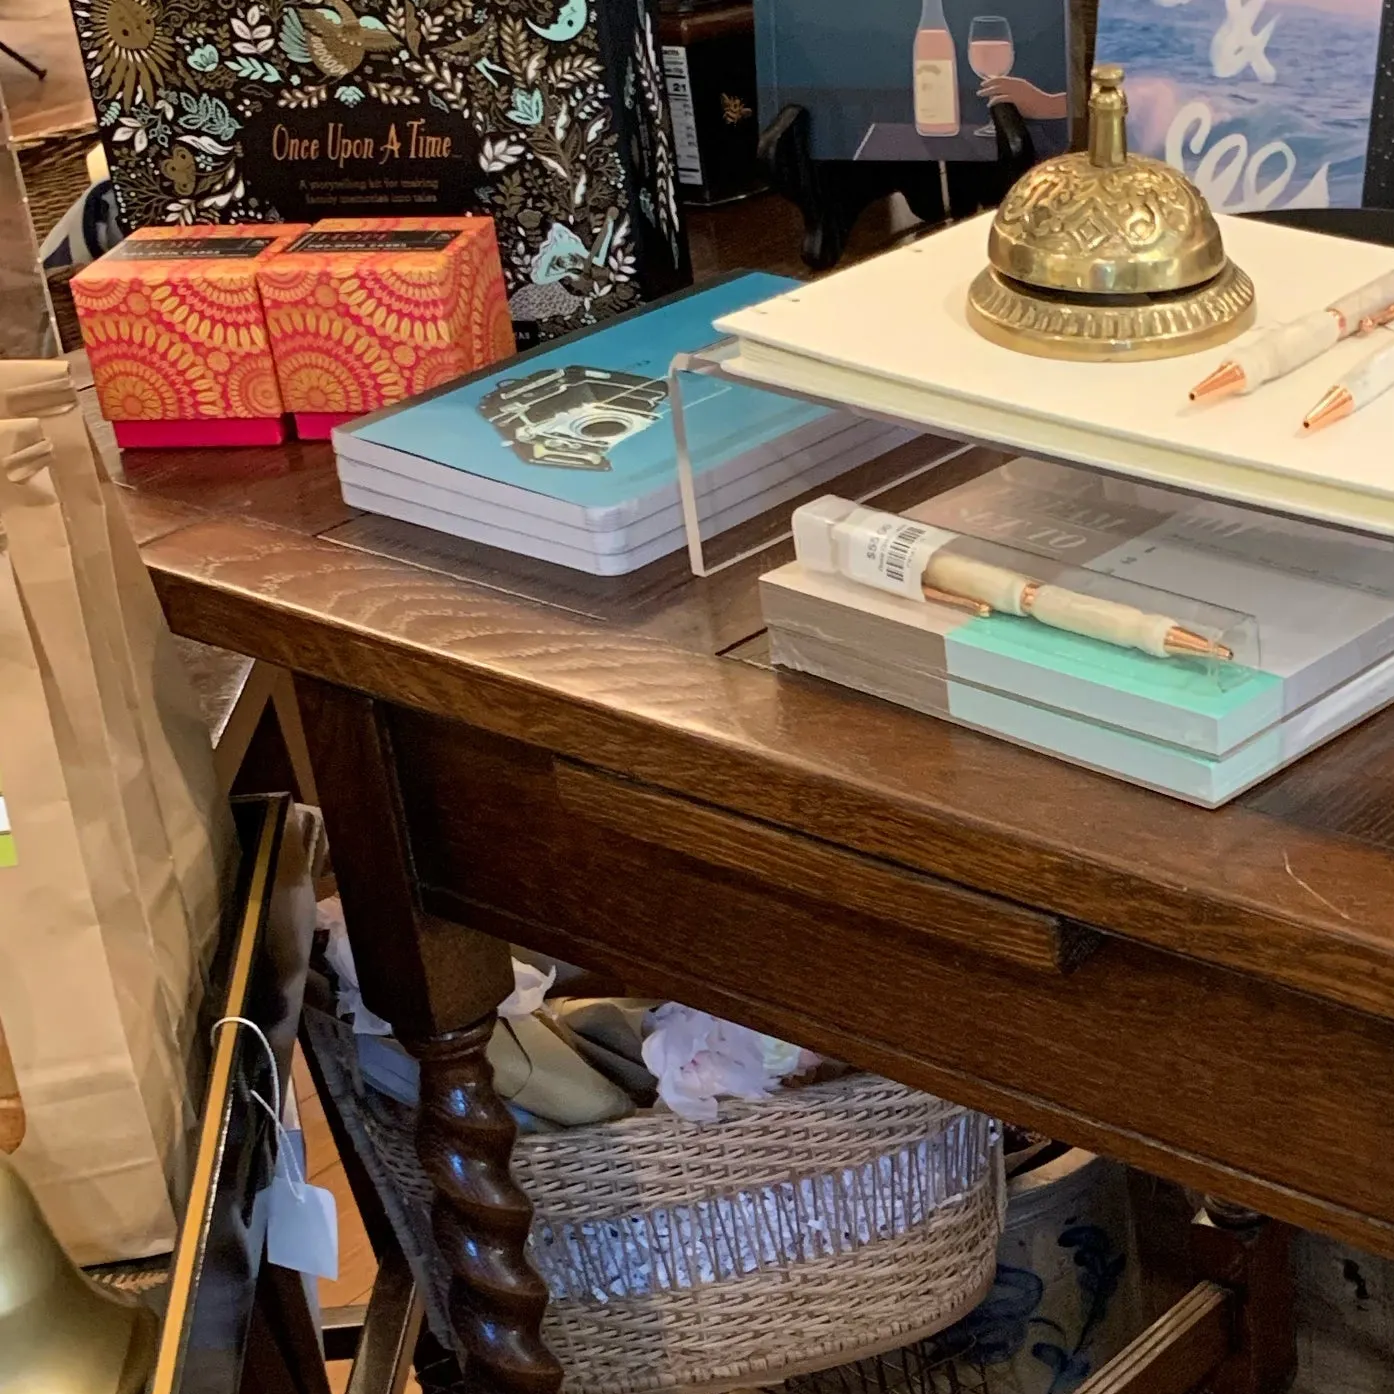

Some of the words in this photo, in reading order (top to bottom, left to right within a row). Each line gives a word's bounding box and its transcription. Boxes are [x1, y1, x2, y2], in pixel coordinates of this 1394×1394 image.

[672, 83, 687, 92] 21
[272, 123, 320, 161] Once
[327, 122, 374, 168] Upon
[379, 122, 401, 165] A
